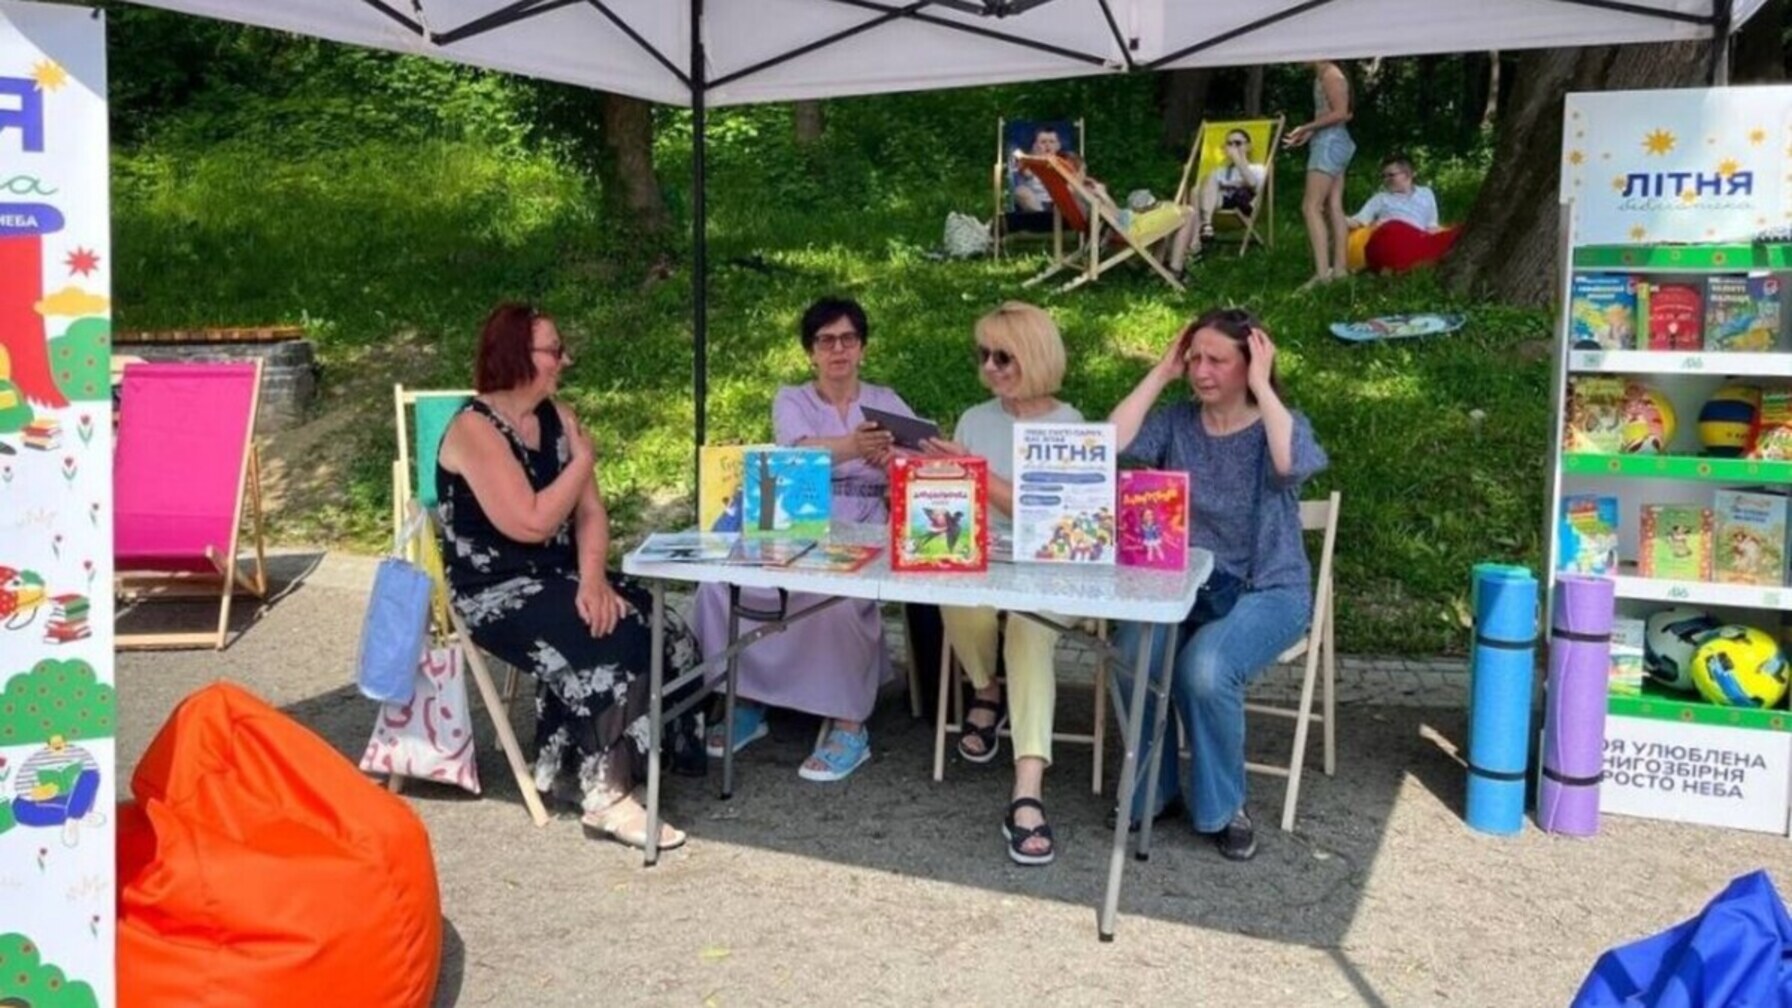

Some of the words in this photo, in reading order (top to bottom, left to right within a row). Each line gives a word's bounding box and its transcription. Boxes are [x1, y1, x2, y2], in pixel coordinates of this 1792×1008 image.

[1622, 171, 1753, 197] ЛІТНЯ
[1025, 444, 1106, 461] ЛІТНЯ
[1632, 742, 1766, 769] УЛЮБЛЕНА
[1603, 756, 1745, 783] НИГОЗБІРНЯ
[1602, 770, 1675, 791] РОСТО
[1682, 779, 1744, 799] НЕБА
